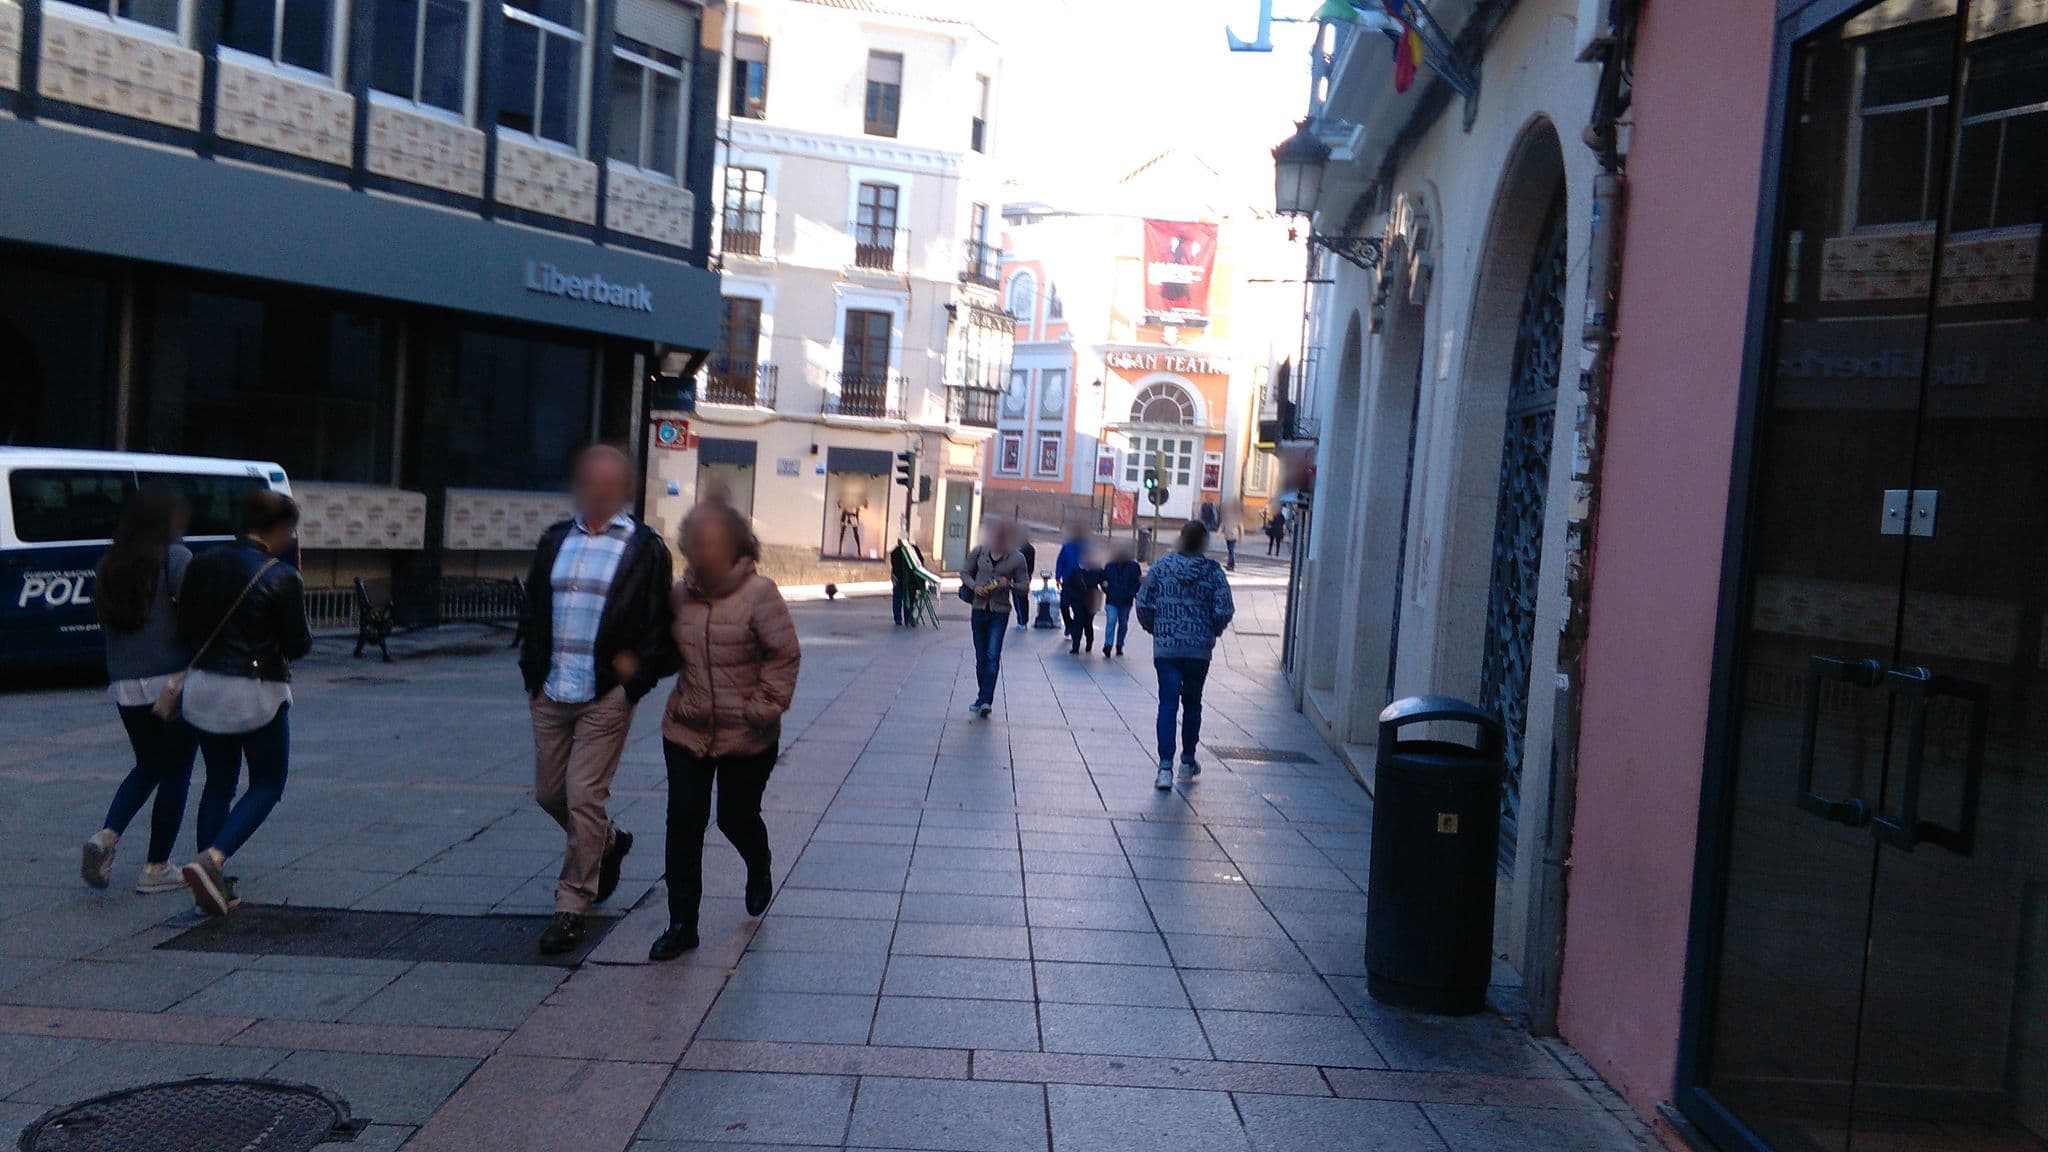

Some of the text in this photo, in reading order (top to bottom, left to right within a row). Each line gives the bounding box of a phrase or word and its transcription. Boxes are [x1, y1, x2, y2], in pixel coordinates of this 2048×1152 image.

[526, 259, 653, 312] Liberbank
[1107, 351, 1157, 370] GRAN
[18, 576, 92, 608] POL
